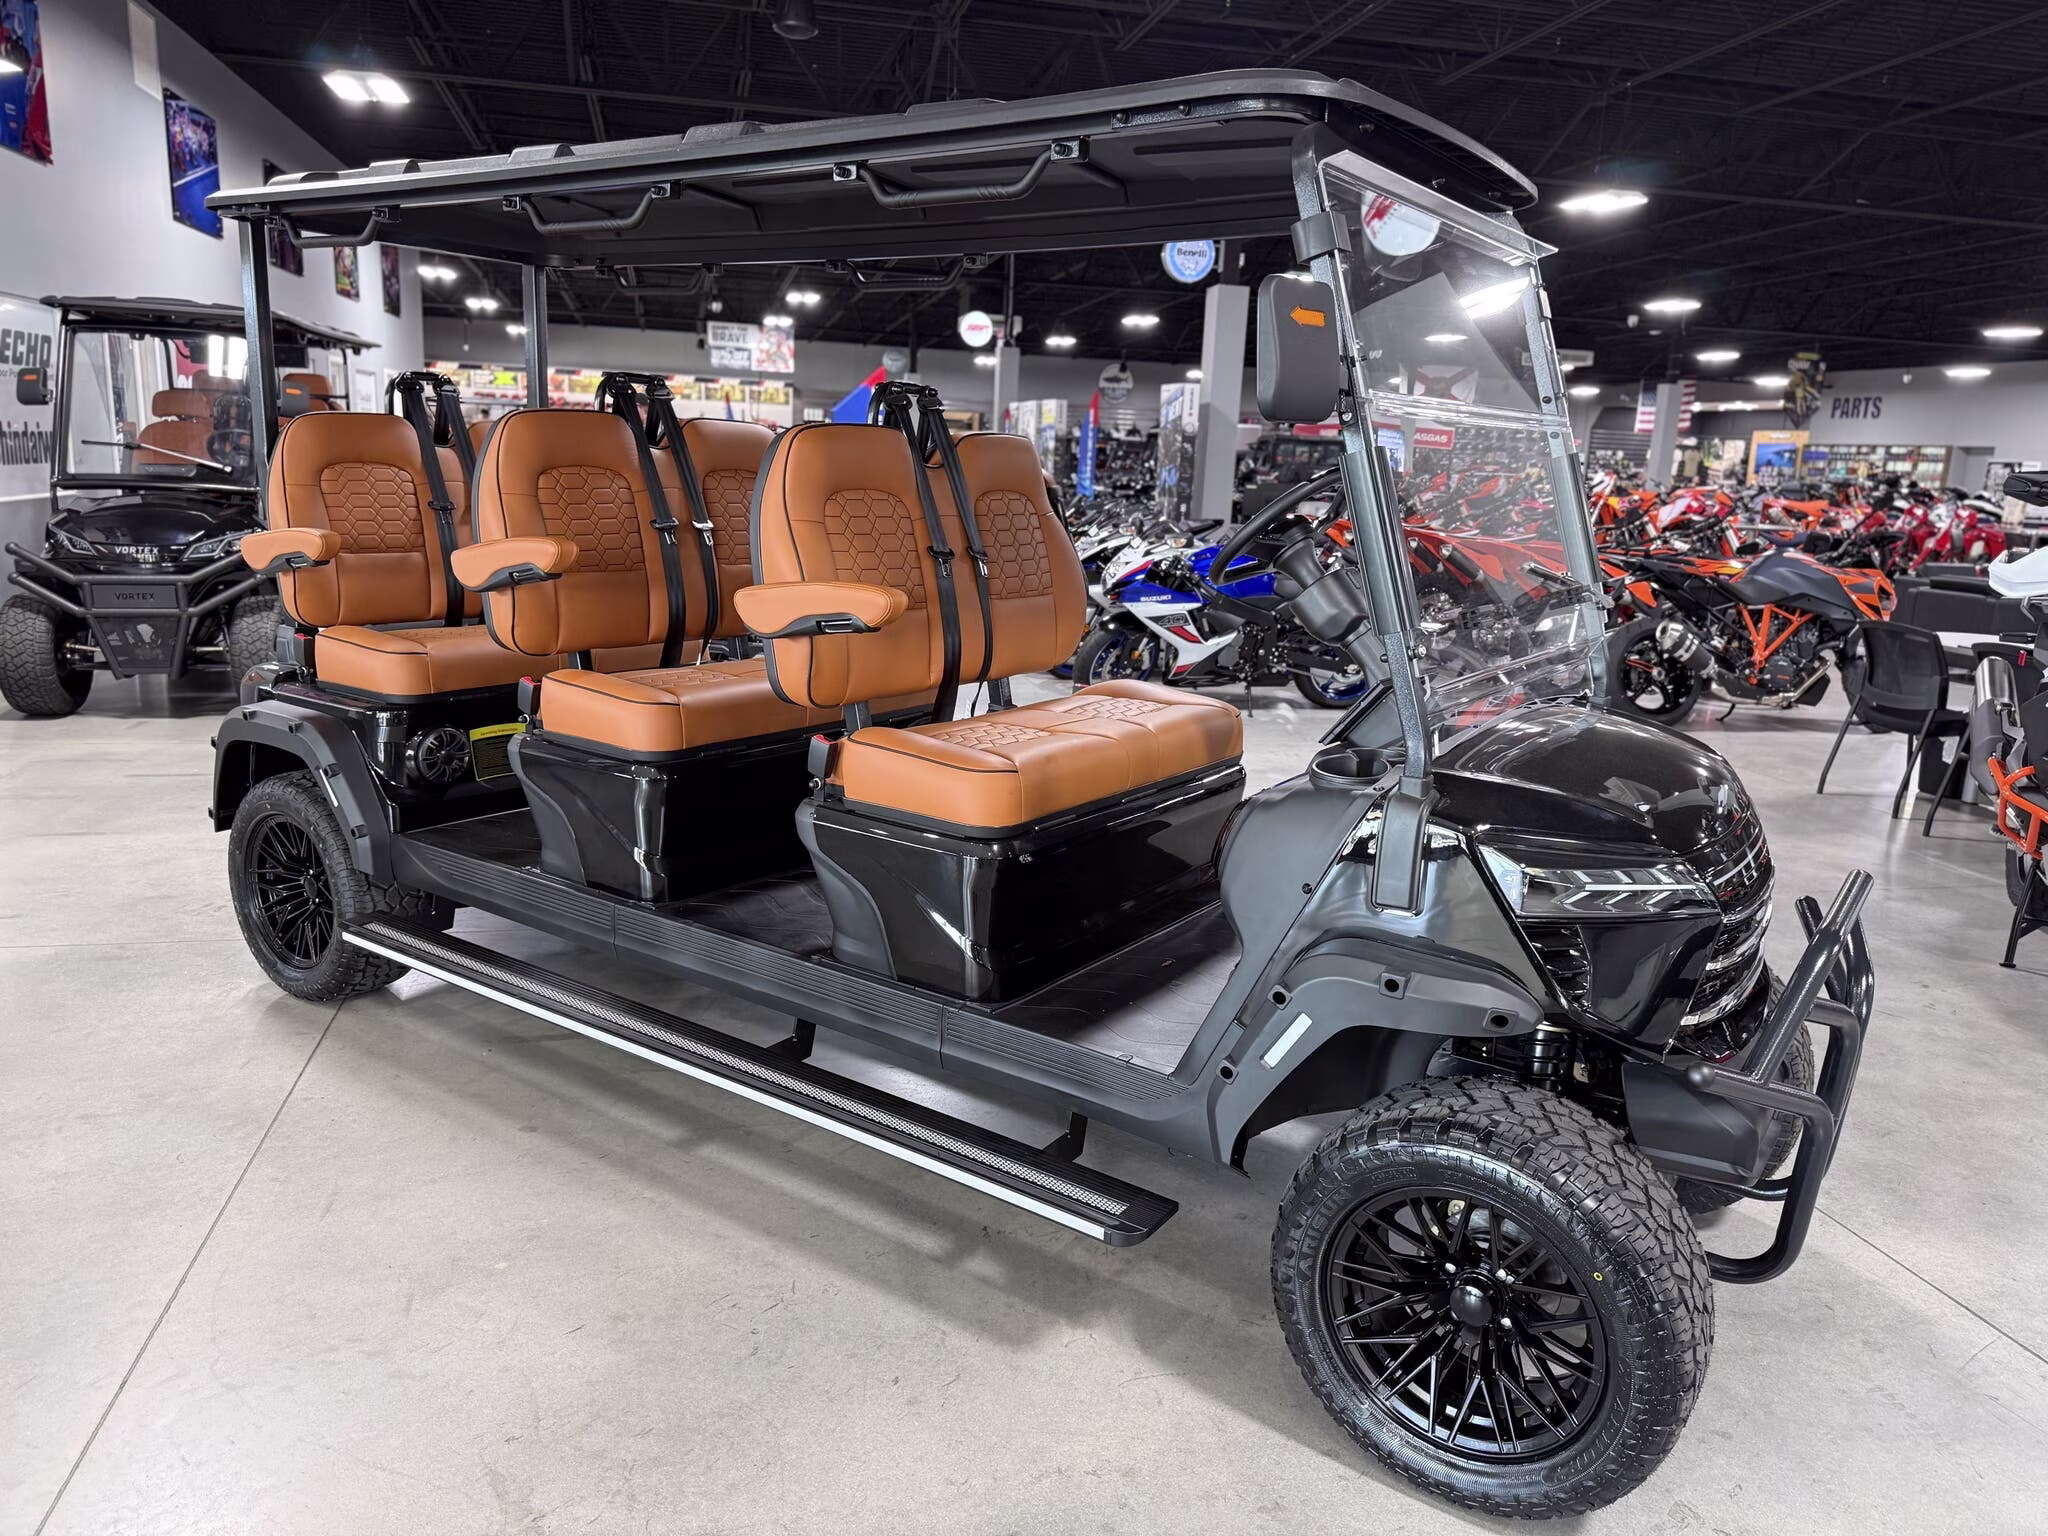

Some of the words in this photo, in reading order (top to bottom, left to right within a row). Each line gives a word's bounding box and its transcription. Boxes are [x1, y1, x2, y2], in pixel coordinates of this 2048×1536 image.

[0, 328, 52, 368] ECHO
[1830, 396, 1882, 419] PARTS
[0, 420, 52, 466] hindaiw
[1414, 431, 1449, 443] ASGAS
[114, 545, 159, 554] VORTEX
[114, 592, 155, 600] VORTEX
[1140, 594, 1172, 602] SUZUKI
